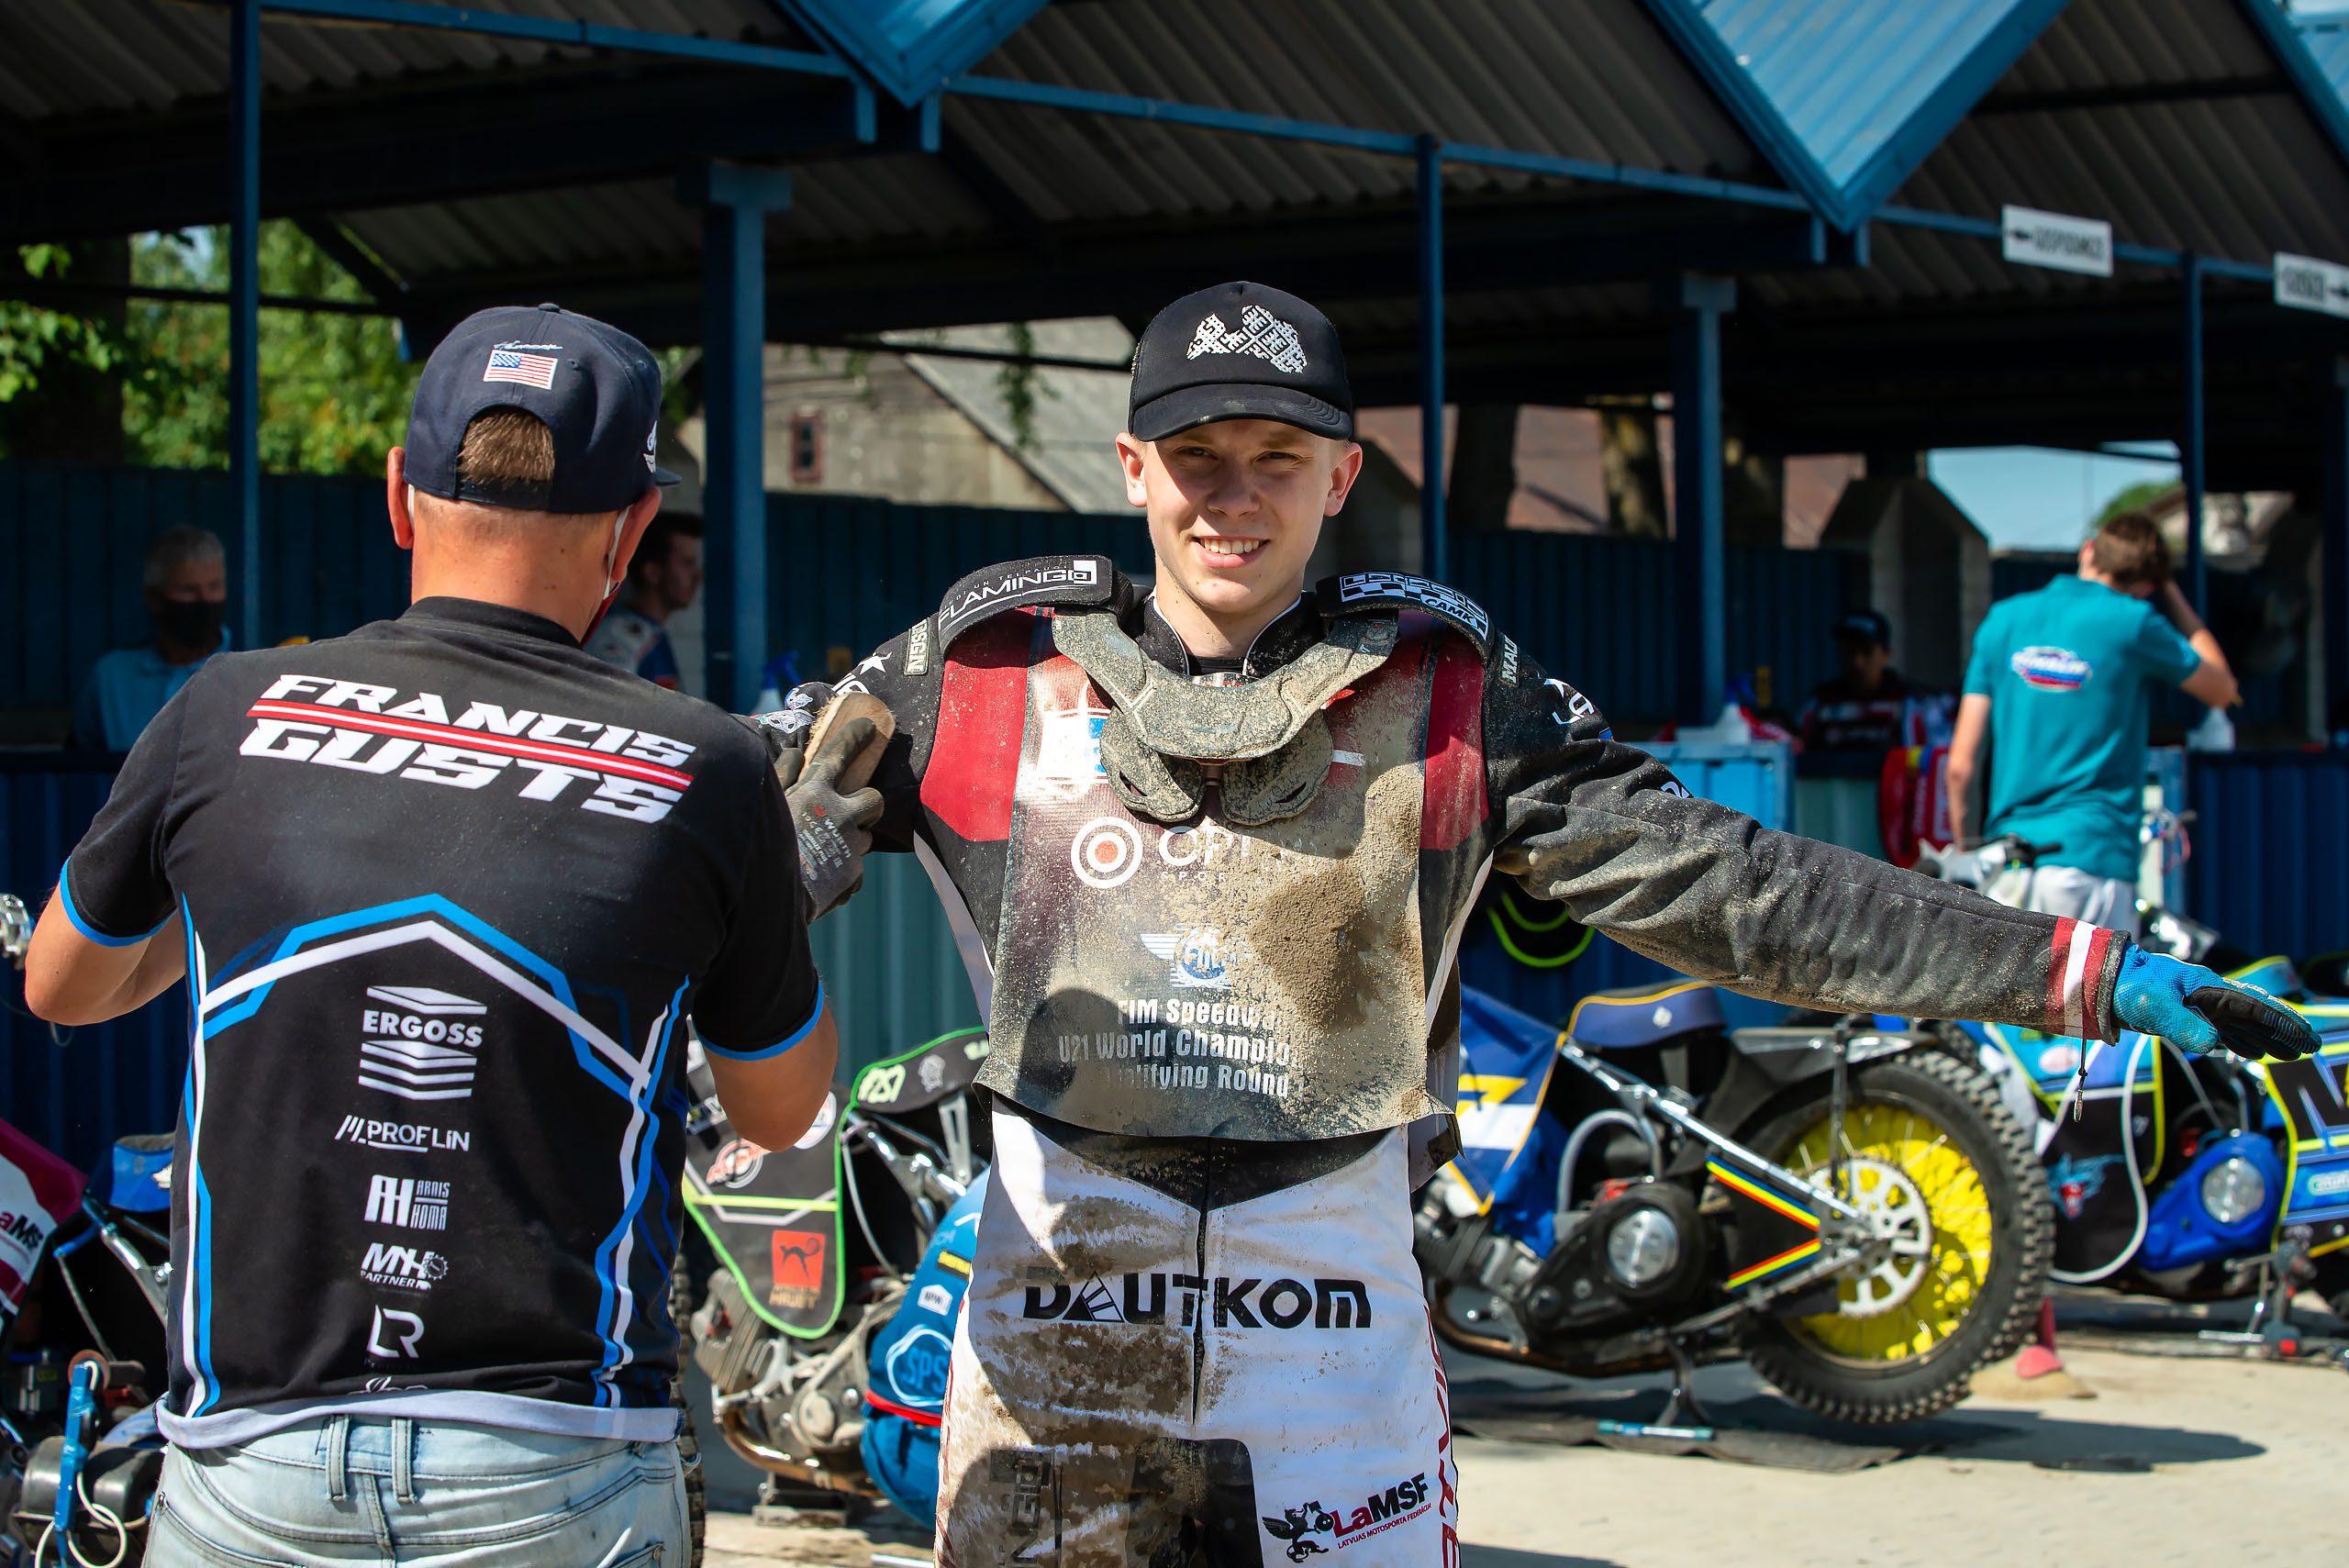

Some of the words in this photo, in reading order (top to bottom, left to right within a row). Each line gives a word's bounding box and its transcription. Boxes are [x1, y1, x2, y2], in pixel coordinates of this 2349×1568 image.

[1424, 597, 1475, 626] CAMK
[260, 674, 696, 767] FRANCIS
[239, 718, 683, 824] GUSTS
[1118, 998, 1158, 1024] FIM
[362, 1009, 484, 1048] ERGOSS
[1058, 1034, 1089, 1062] U21
[1096, 1029, 1166, 1060] World
[1218, 1065, 1289, 1098] Round
[1329, 1472, 1429, 1539] LaMSF
[1366, 1517, 1408, 1538] MOTOSPORTA
